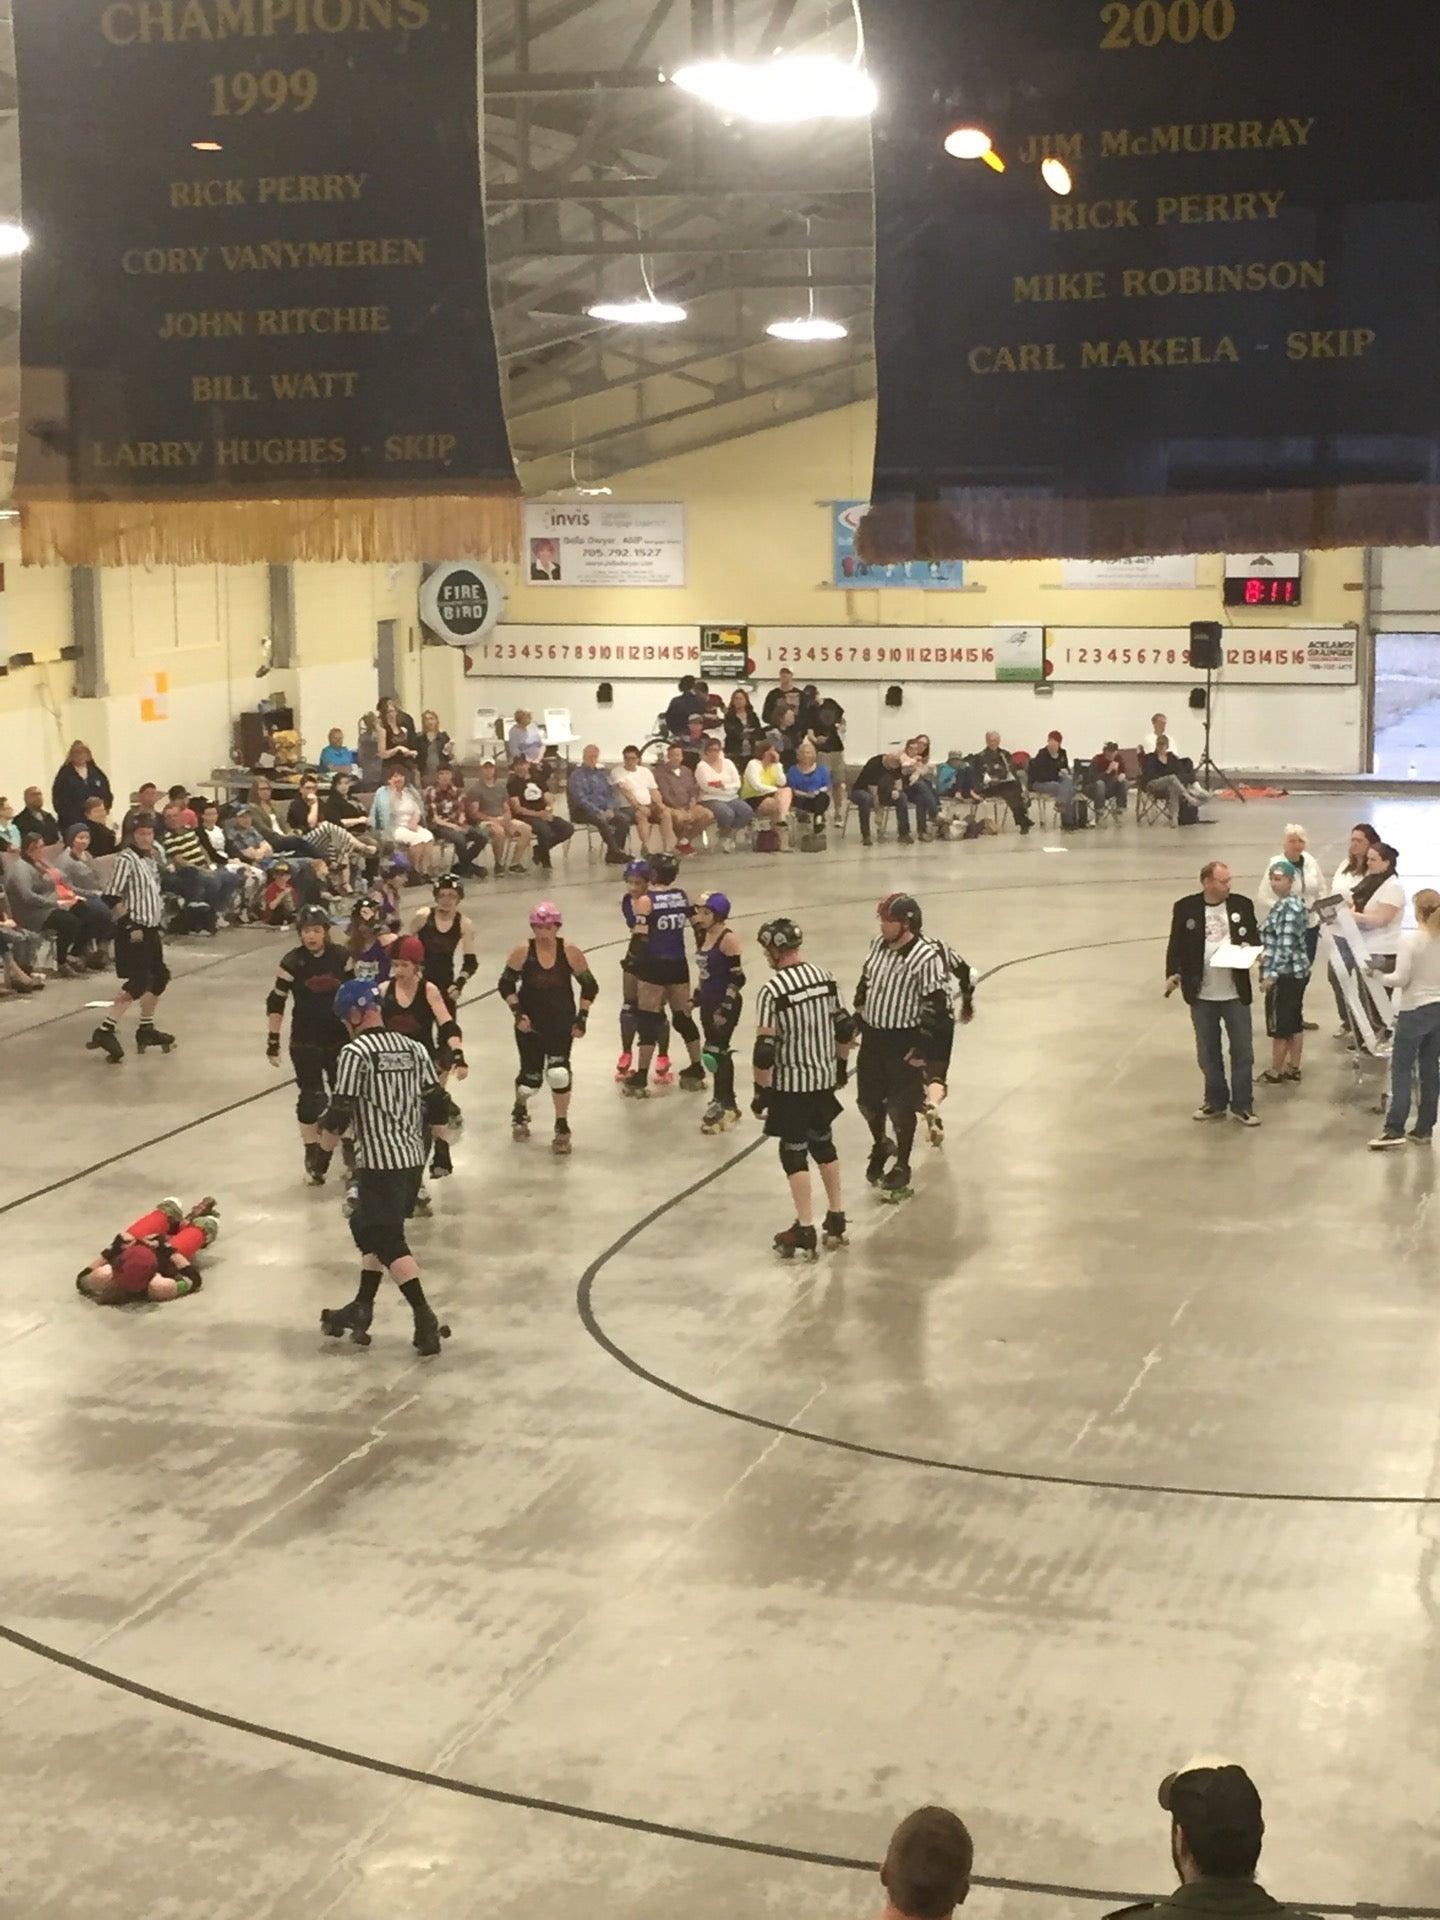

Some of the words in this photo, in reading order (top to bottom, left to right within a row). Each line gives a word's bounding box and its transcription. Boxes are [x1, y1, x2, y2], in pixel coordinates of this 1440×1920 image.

[102, 0, 429, 45] CHAMPIONS
[1100, 0, 1236, 50] 2000
[210, 69, 318, 116] 1999
[1020, 132, 1084, 163] JIM
[1100, 117, 1315, 157] McMURRAY
[169, 179, 246, 208] RICK
[258, 172, 367, 205] PERRY
[1050, 199, 1139, 231] RICK
[1156, 190, 1286, 225] PERRY
[122, 245, 209, 275] CORY
[221, 238, 427, 272] VANYMEREN
[1012, 271, 1107, 303] MIKE
[1122, 259, 1325, 298] ROBINSON
[159, 310, 243, 340] JOHN
[257, 305, 390, 335] RITCHIE
[967, 344, 1065, 375] CARL
[1080, 336, 1239, 369] MAKELA
[1286, 329, 1376, 362] SKIP
[191, 374, 258, 402] BILL
[270, 372, 359, 400] WATT
[93, 441, 204, 467] LARRY
[216, 437, 347, 466] HUGHES
[384, 433, 457, 463] SKIP
[551, 511, 590, 526] invis
[443, 584, 480, 600] FIRE
[1246, 578, 1293, 603] 8:11
[443, 605, 482, 620] BIRD
[494, 645, 503, 659] 2
[508, 645, 516, 659] 3
[521, 645, 530, 659] 4
[534, 645, 543, 659] 5
[548, 645, 557, 659] 6
[561, 645, 570, 659] 7
[574, 645, 583, 659] 8
[588, 645, 596, 659] 9
[600, 646, 611, 660] 10
[616, 646, 624, 660] 11
[628, 646, 640, 660] 12
[643, 646, 655, 660] 13
[658, 646, 670, 660] 14
[672, 646, 684, 660] 15
[687, 646, 699, 660] 16
[779, 647, 788, 661] 2
[793, 647, 801, 661] 3
[806, 647, 816, 661] 4
[821, 647, 829, 661] 5
[835, 647, 843, 661] 6
[849, 647, 857, 661] 7
[862, 647, 870, 661] 8
[877, 647, 885, 661] 9
[889, 647, 900, 662] 10
[906, 647, 914, 662] 11
[920, 647, 932, 662] 12
[935, 647, 947, 662] 13
[950, 647, 963, 662] 14
[966, 647, 978, 662] 15
[981, 647, 994, 662] 16
[1078, 648, 1087, 662] 2
[1093, 648, 1101, 662] 3
[1107, 648, 1117, 662] 4
[1122, 649, 1131, 663] 5
[1137, 649, 1146, 663] 6
[1152, 649, 1161, 663] 7
[1166, 649, 1175, 663] 8
[1181, 649, 1190, 664] 9
[1227, 649, 1239, 664] 12
[1243, 649, 1255, 664] 13
[1260, 649, 1272, 664] 14
[1276, 649, 1287, 664] 15
[1292, 649, 1304, 664] 16
[657, 913, 686, 930] 6T9
